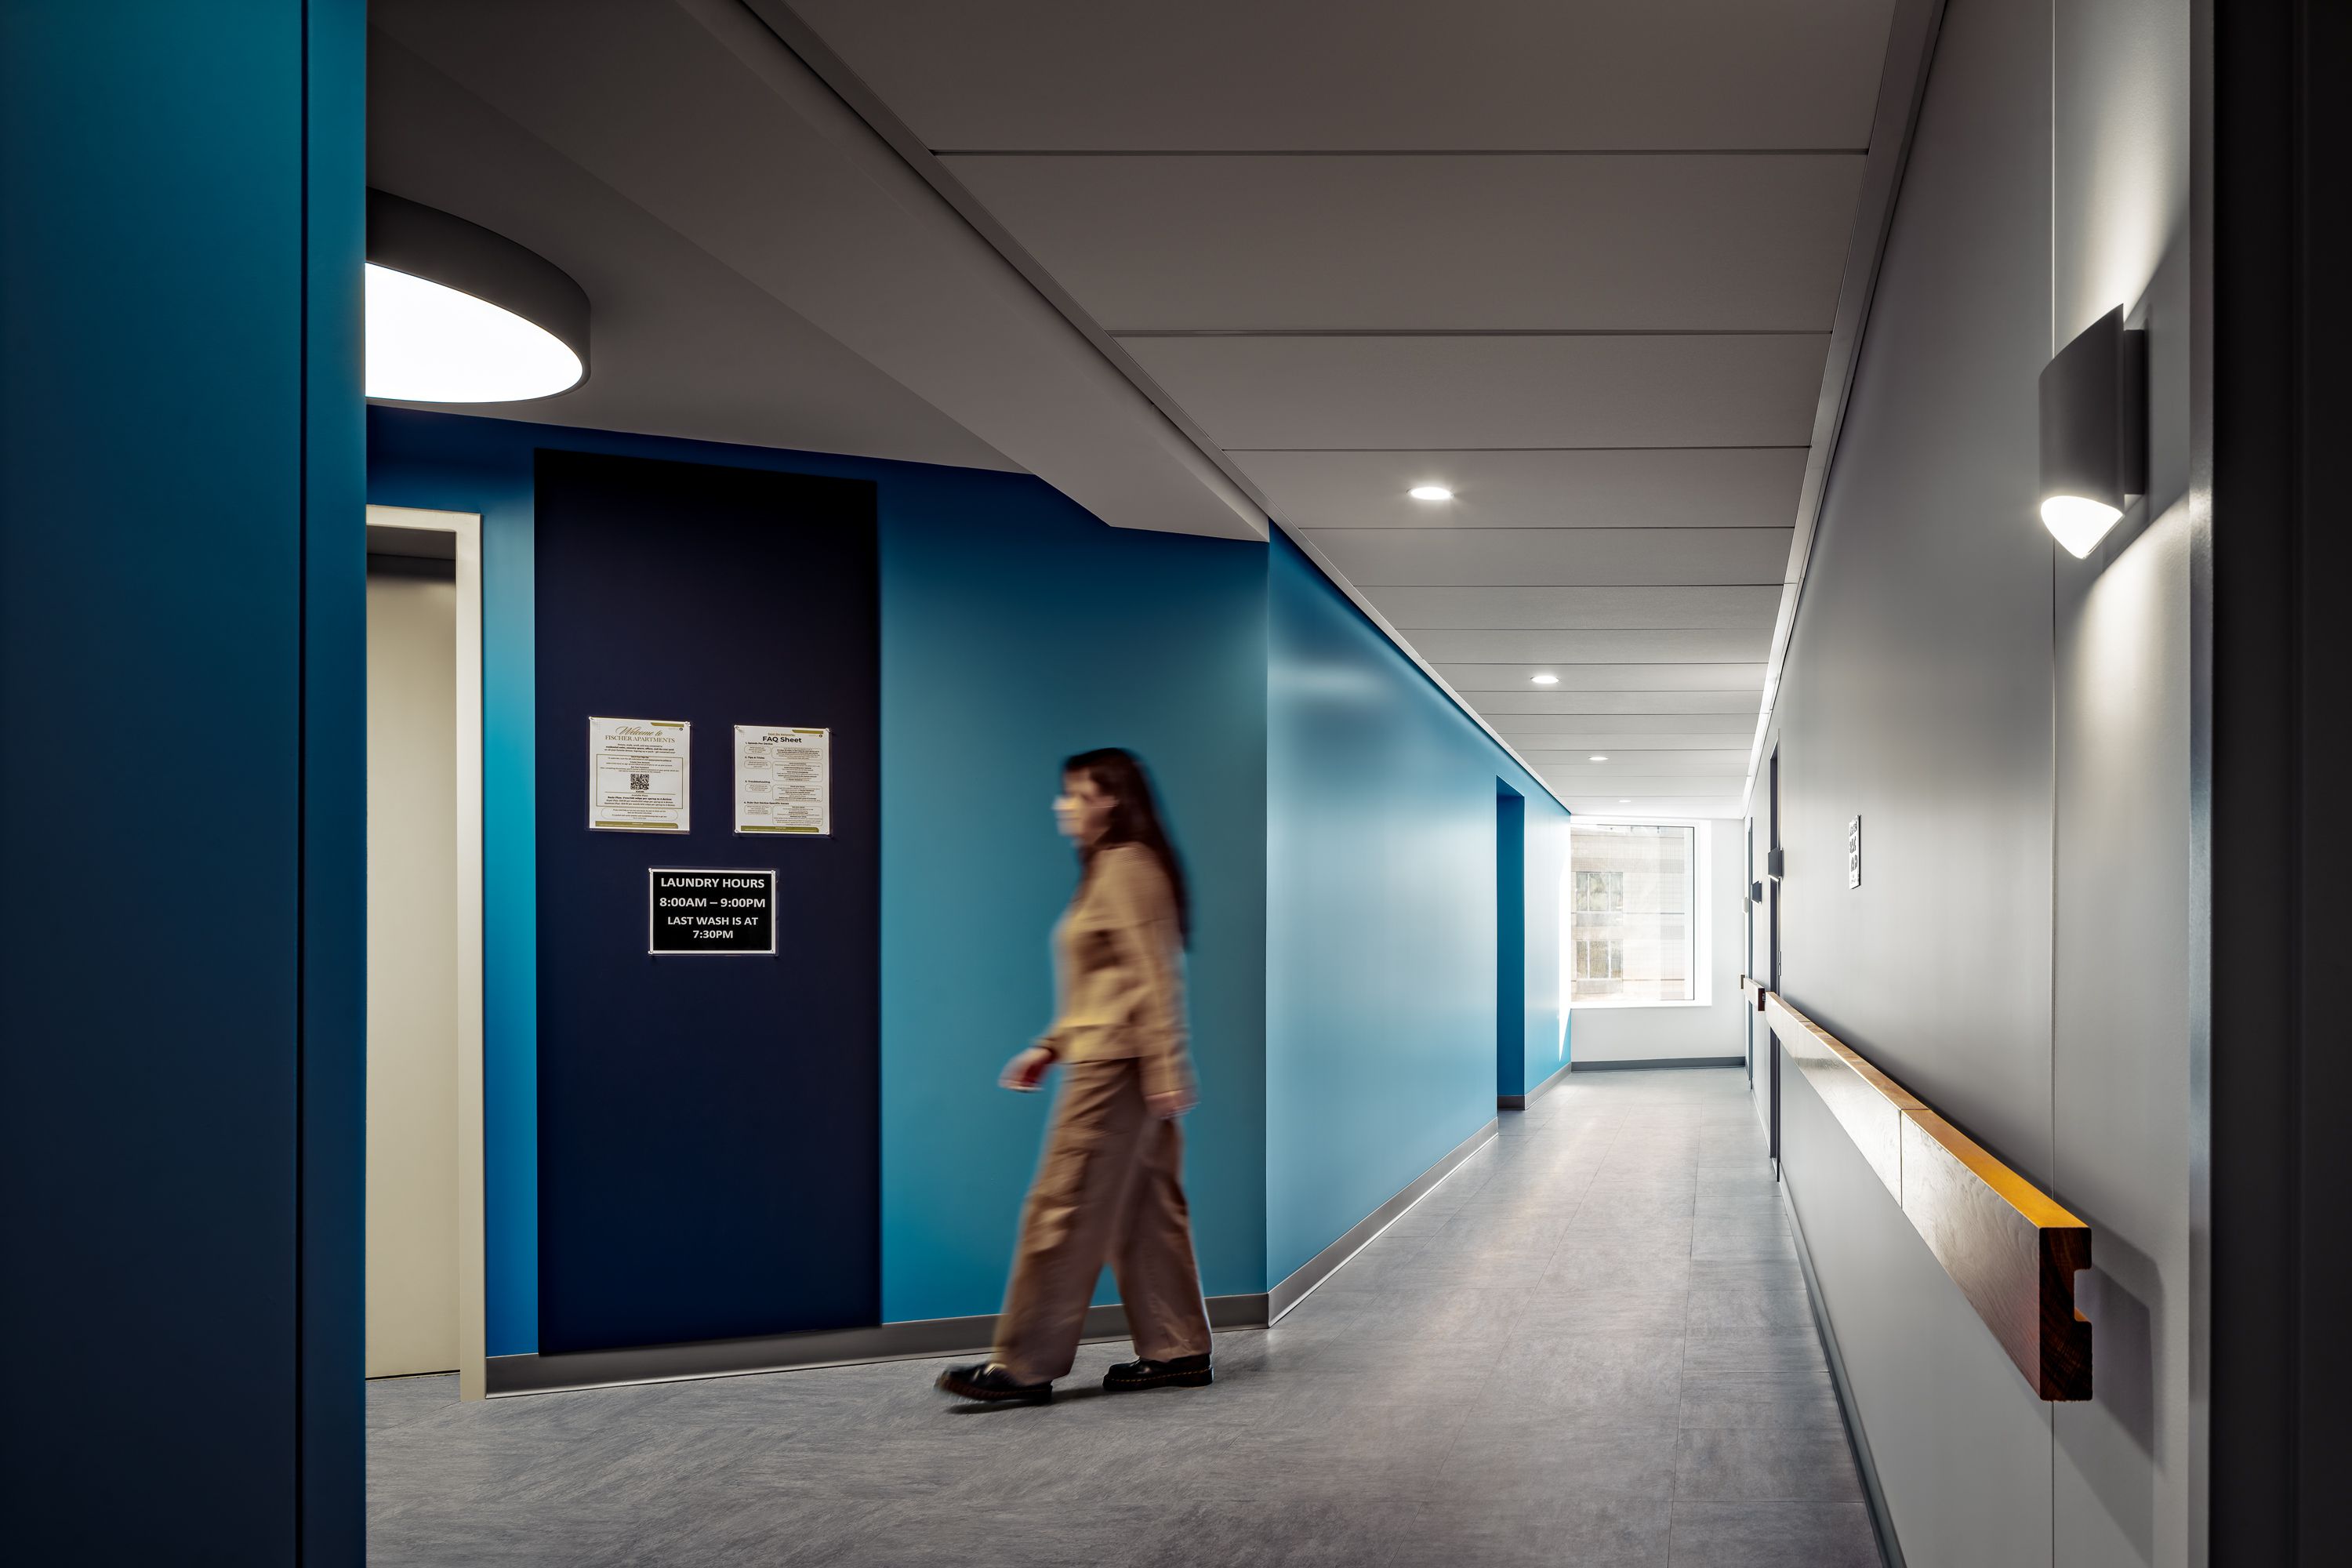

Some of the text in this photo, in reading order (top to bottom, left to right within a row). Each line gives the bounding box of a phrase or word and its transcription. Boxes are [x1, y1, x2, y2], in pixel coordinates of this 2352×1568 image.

[615, 726, 655, 736] Welcome
[660, 877, 765, 888] LAUNDRY HOURS
[659, 897, 707, 907] 8:00AM
[720, 898, 766, 908] 9:00PM
[667, 916, 759, 926] LAST WASH IS AT
[692, 930, 734, 939] 7:30PM
